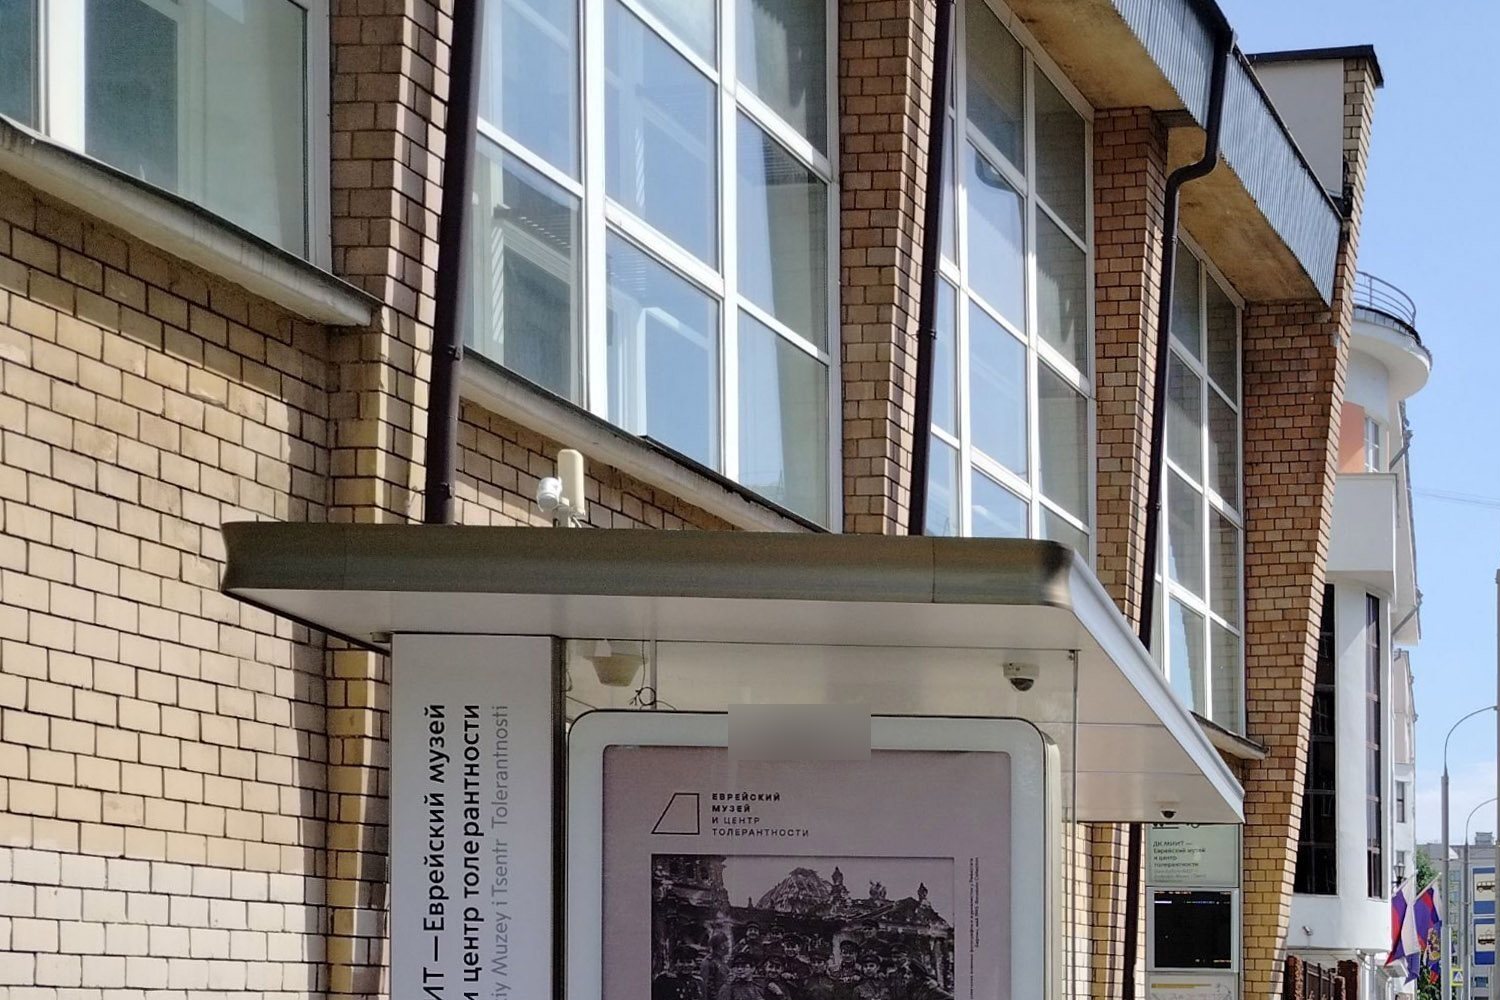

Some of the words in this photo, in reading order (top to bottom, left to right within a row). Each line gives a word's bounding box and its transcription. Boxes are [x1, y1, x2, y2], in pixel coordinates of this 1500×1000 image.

[424, 704, 450, 783] музей
[491, 705, 508, 829] Tolerantnosti
[464, 704, 484, 898] толерантности
[712, 792, 780, 801] ЕВРЕЙСКИЙ
[712, 804, 751, 812] МУЗЕЙ
[712, 816, 718, 824] И
[724, 816, 760, 825] ЦЕНТР
[424, 793, 449, 932] Еврейский
[712, 828, 809, 836] ТОЛЕРАНТНОСТИ
[491, 839, 508, 898] Tsentr
[464, 906, 484, 982] центр
[491, 912, 512, 976] Muzey
